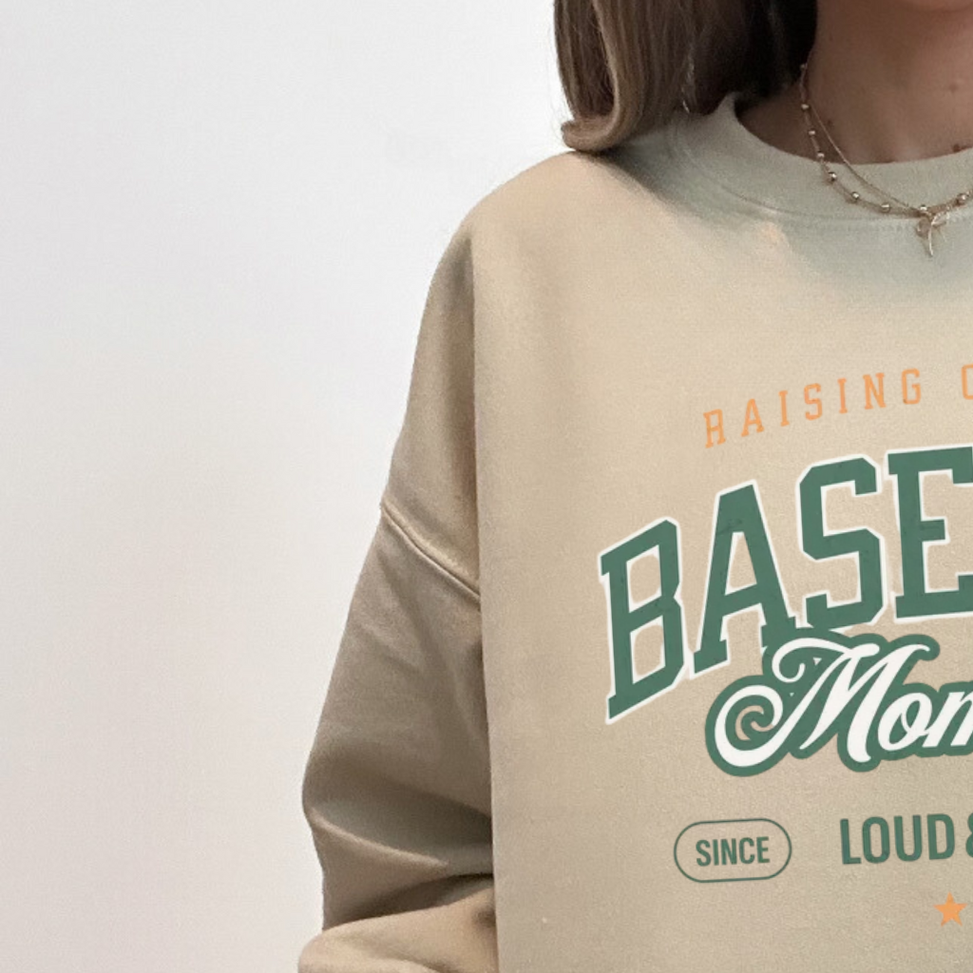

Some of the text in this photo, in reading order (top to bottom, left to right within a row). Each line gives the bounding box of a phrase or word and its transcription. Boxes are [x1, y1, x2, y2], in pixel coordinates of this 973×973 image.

[703, 368, 924, 448] RAISING
[695, 836, 771, 869] SINCE
[840, 815, 956, 865] LOUD
